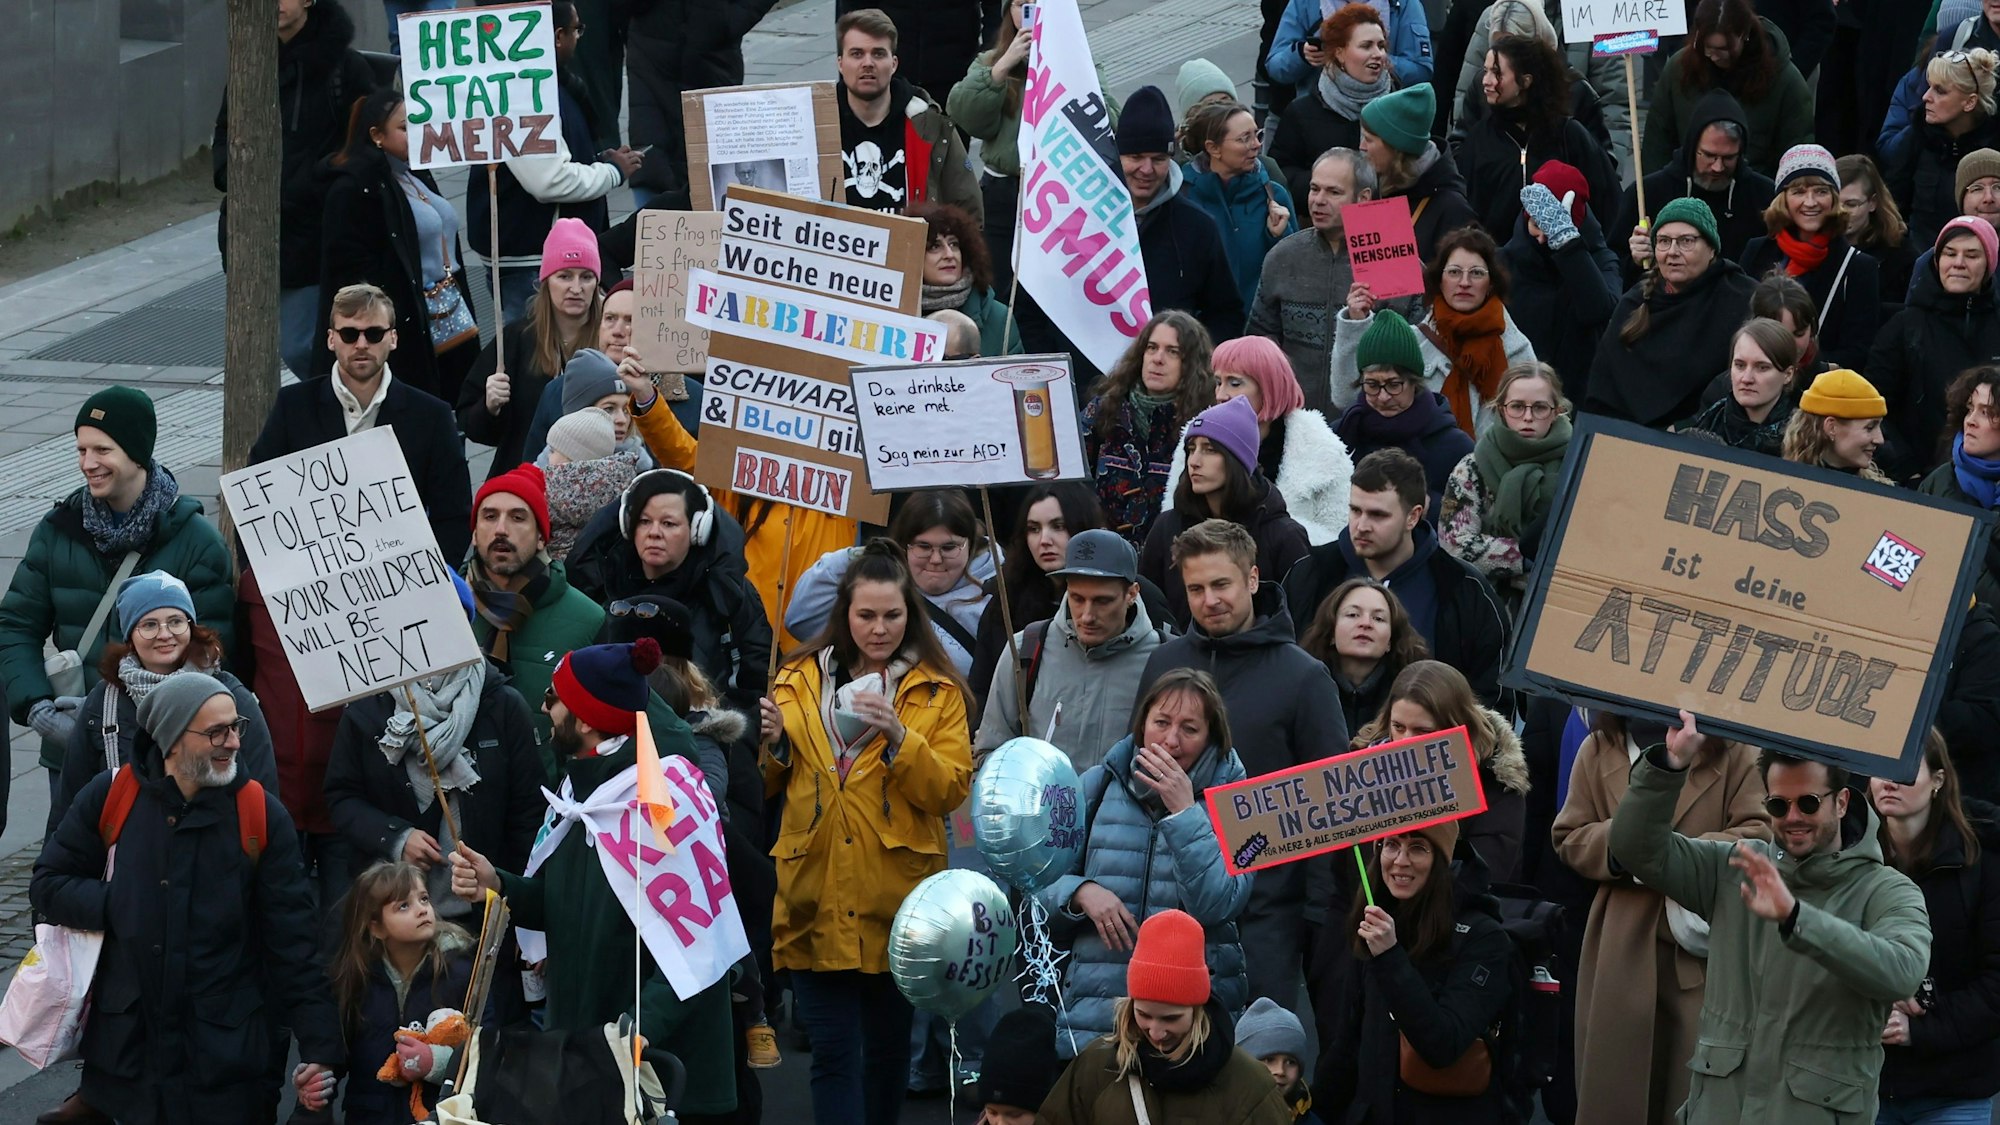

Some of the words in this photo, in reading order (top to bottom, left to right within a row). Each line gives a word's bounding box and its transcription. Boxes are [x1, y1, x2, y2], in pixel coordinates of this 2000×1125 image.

[419, 10, 545, 71] HERZ
[1571, 4, 1594, 28] IM
[408, 69, 554, 124] STATT
[420, 114, 557, 164] MERZ
[1040, 115, 1132, 239] VEEDEL
[641, 214, 667, 240] Es
[674, 216, 705, 247] fing
[727, 207, 783, 240] Seit
[795, 221, 879, 258] dieser
[1350, 232, 1381, 248] SEID
[1353, 243, 1415, 264] MENSCHEN
[641, 245, 665, 270] Es
[725, 244, 818, 286] Woche
[828, 270, 893, 302] neue
[641, 273, 684, 298] WIR
[640, 303, 665, 318] mit
[657, 322, 689, 348] fing
[695, 283, 938, 363] FARBLEHRE
[868, 382, 896, 397] Da
[908, 376, 966, 395] drinkste
[874, 401, 915, 416] keine
[705, 396, 727, 423] &
[743, 405, 813, 440] BLaU
[231, 471, 274, 511] IF
[286, 447, 348, 497] YOU
[877, 445, 909, 467] Sag
[913, 447, 939, 460] nein
[944, 447, 964, 458] zur
[973, 443, 1007, 460] AfD!
[734, 452, 848, 511] BRAUN
[239, 476, 417, 556] TOLERATE
[1664, 463, 1840, 558] HASS
[375, 538, 404, 551] then
[1866, 549, 1912, 583] NZS
[1875, 535, 1921, 570] KCK
[272, 580, 340, 624] YOUR
[340, 547, 451, 606] CHILDREN
[1661, 547, 1702, 580] ist
[1734, 566, 1807, 611] deine
[285, 622, 345, 655] WILL
[346, 606, 384, 638] BE
[338, 620, 431, 692] NEXT
[1574, 587, 1898, 729] ATTITÜDE
[1233, 777, 1310, 820] BIETE
[1323, 740, 1456, 797] NACHHILFE
[1278, 810, 1303, 839] IN
[1307, 774, 1455, 830] GESCHICHTE
[1278, 840, 1304, 855] MERZ
[1313, 834, 1330, 846] ALLE
[1399, 813, 1413, 824] DES
[1414, 802, 1459, 820] FASCHISMUS!
[1237, 836, 1265, 866] GRATIS
[967, 932, 998, 957] IST
